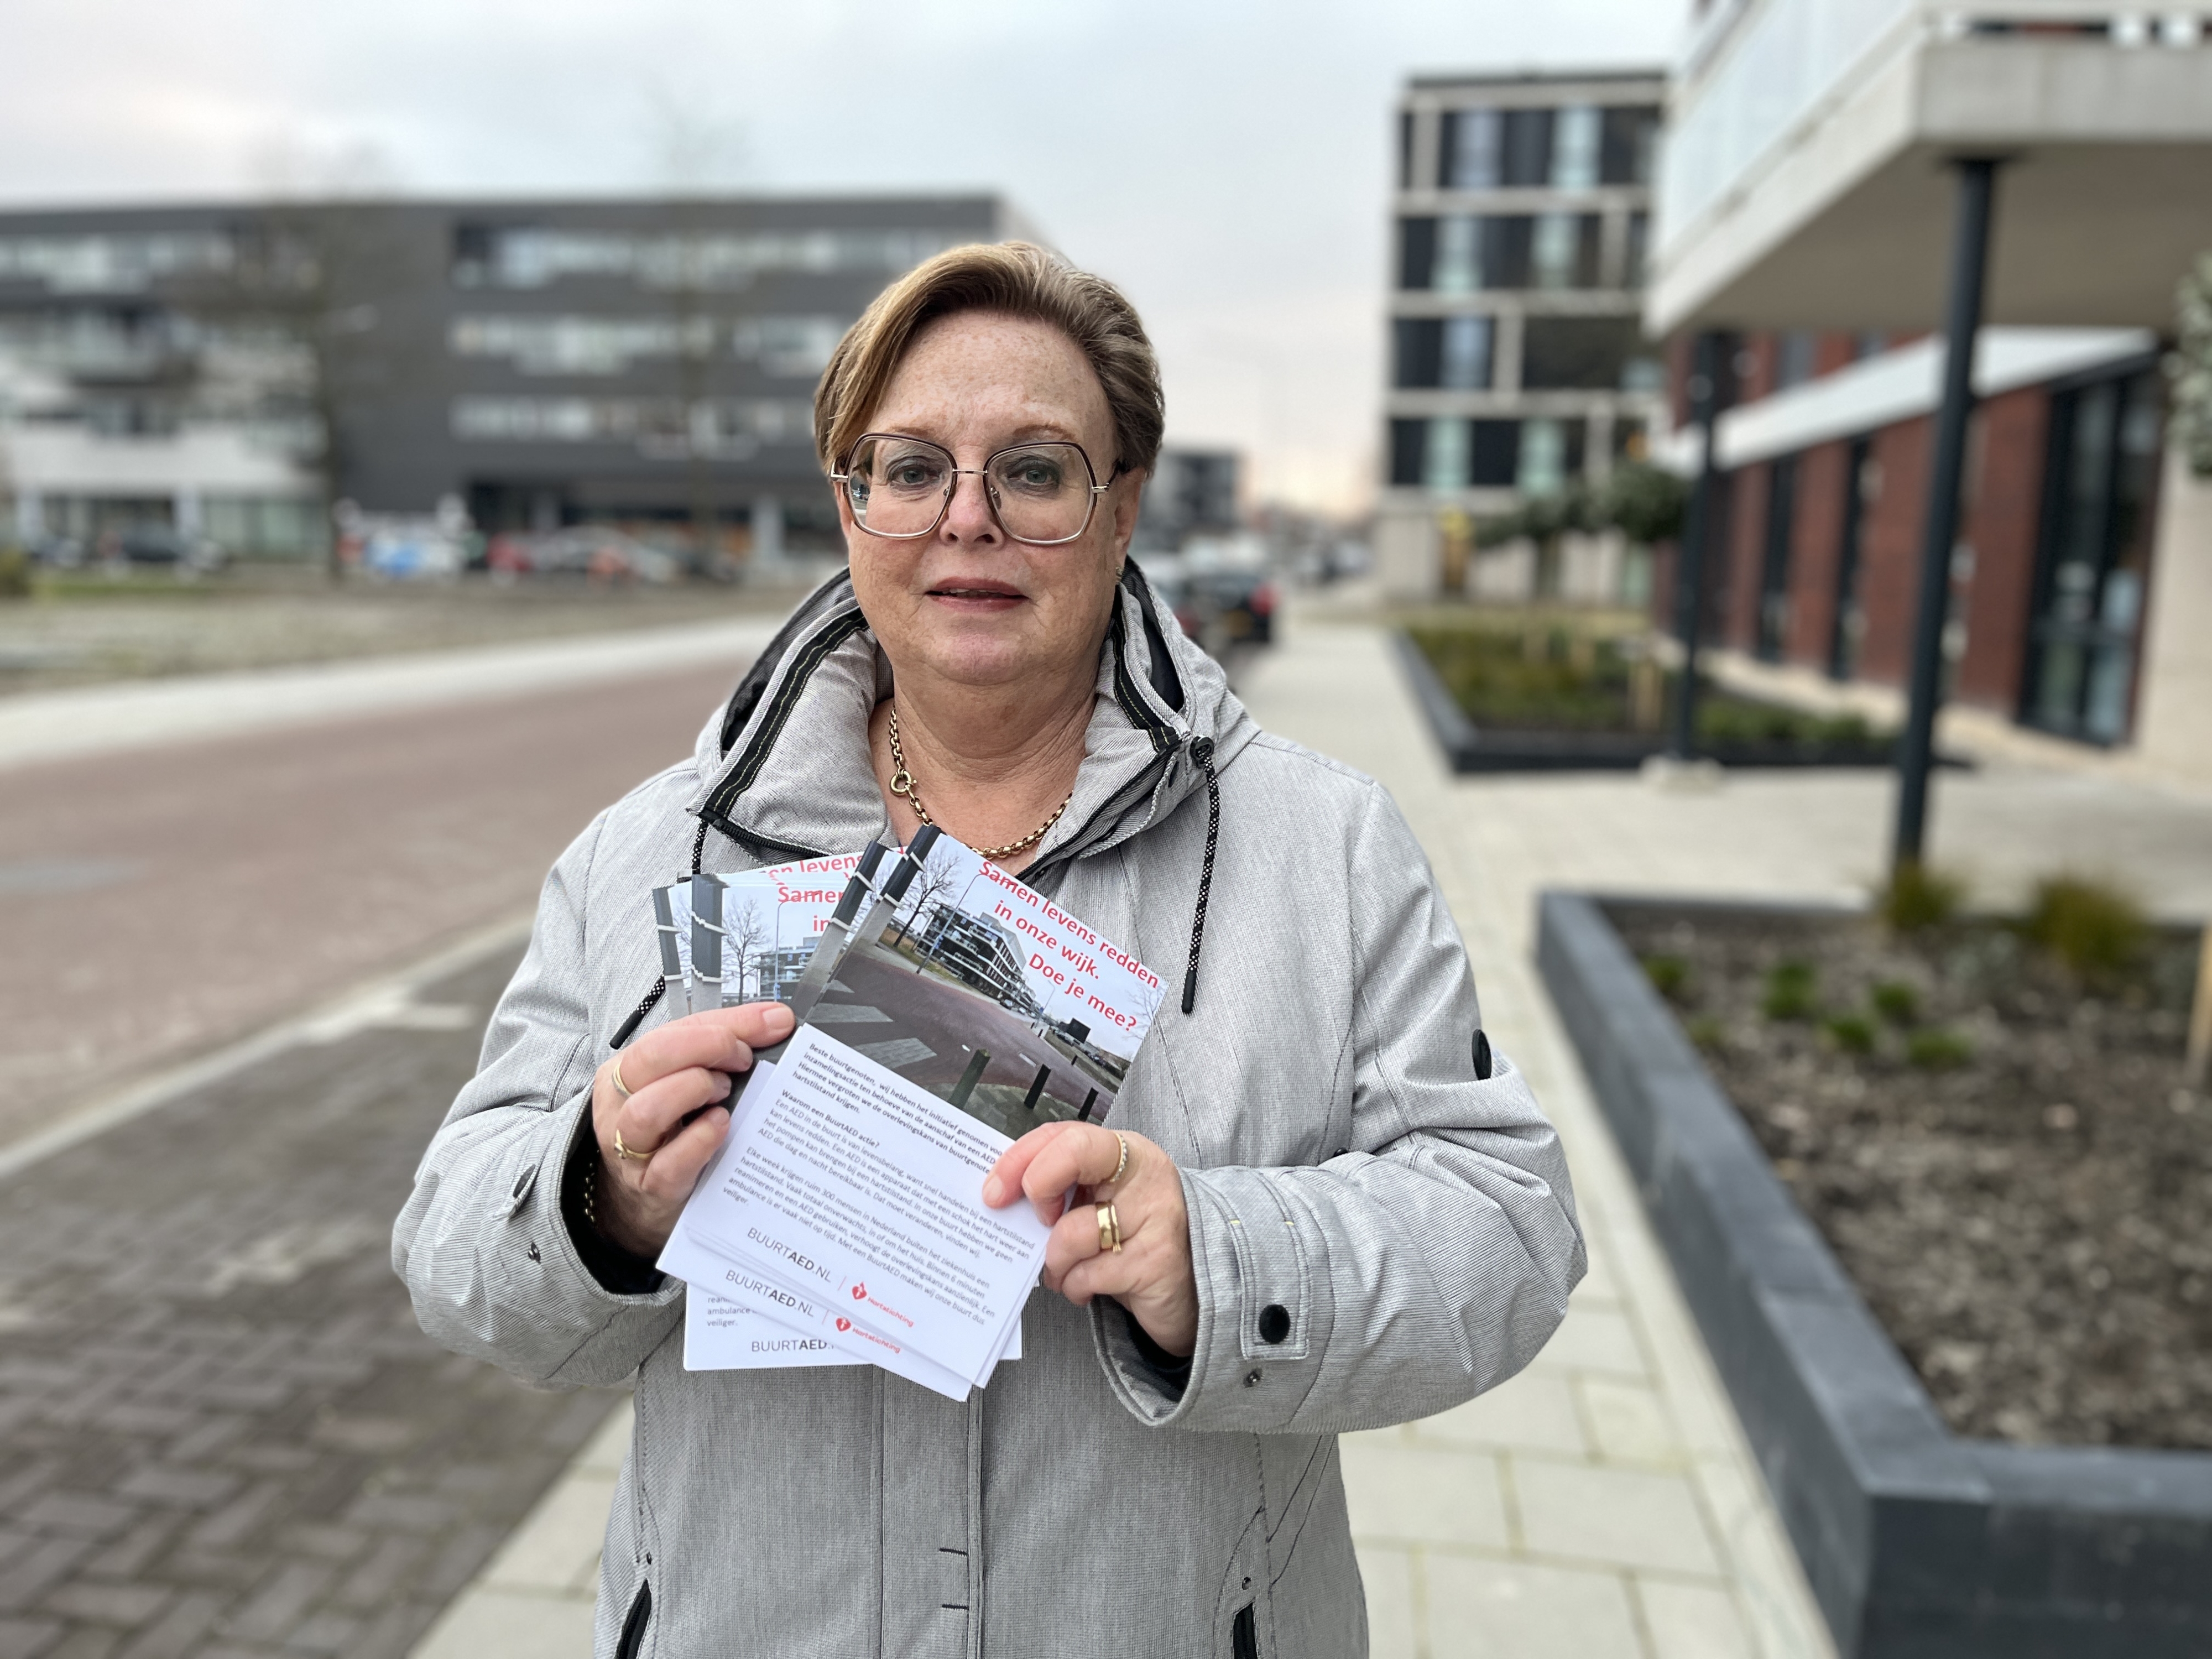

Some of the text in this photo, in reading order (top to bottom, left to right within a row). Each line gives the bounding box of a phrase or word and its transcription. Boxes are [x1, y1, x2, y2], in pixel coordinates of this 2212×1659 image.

[979, 859, 1158, 988] Samen levens redden
[995, 901, 1098, 978] in onze wijk.
[1029, 954, 1136, 1031] Doe je mee?
[781, 1089, 880, 1149] Waarom een BuurtAED actie?
[792, 1070, 860, 1114] hartstilstand krijgen.
[797, 1061, 990, 1173] Hiermee vergroten we de overlevingskans van buurtgenote
[803, 1051, 995, 1164] inzamelingsactie ten behoeve van de aanschaf van een AED
[808, 1042, 1001, 1155] Beste buurtgenoten, wij hebben het initiatief genomen voo
[746, 1146, 989, 1288] Elke week krijgen ruim 300 mensen in Nederland buiten het ziekenhuis een
[757, 1128, 773, 1139] AED
[773, 1136, 784, 1146] die
[785, 1143, 798, 1155] dag
[798, 1151, 807, 1160] en
[808, 1156, 828, 1171] nacht
[828, 1166, 864, 1191] bereikbaar
[873, 1192, 886, 1204] Dat
[885, 1201, 904, 1214] moet
[946, 1234, 968, 1250] vinden
[763, 1117, 776, 1129] het
[775, 1126, 805, 1145] pompen
[805, 1140, 817, 1152] kan
[818, 1148, 846, 1168] brengen
[847, 1164, 857, 1175] bij
[856, 1171, 869, 1182] een
[914, 1202, 921, 1211] In
[921, 1208, 938, 1220] onze
[938, 1216, 958, 1232] buurt
[958, 1227, 984, 1246] hebben
[984, 1243, 995, 1253] we
[994, 1250, 1013, 1263] geen
[769, 1108, 782, 1119] kan
[782, 1115, 805, 1132] levens
[832, 1142, 845, 1155] Een
[845, 1151, 860, 1163] AED
[860, 1159, 867, 1167] is
[867, 1165, 880, 1175] een
[880, 1172, 911, 1192] apparaat
[911, 1189, 923, 1199] dat
[922, 1196, 937, 1207] met
[937, 1204, 951, 1215] een
[951, 1212, 970, 1227] schok
[971, 1222, 983, 1233] het
[983, 1229, 998, 1242] hart
[999, 1239, 1016, 1251] weer
[1016, 1249, 1029, 1259] aan
[775, 1098, 789, 1110] Een
[788, 1107, 804, 1118] AED
[804, 1114, 811, 1123] in
[811, 1120, 821, 1129] de
[821, 1124, 841, 1140] buurt
[841, 1135, 847, 1144] is
[848, 1140, 860, 1151] van
[906, 1173, 924, 1187] want
[923, 1183, 938, 1195] snel
[938, 1190, 969, 1213] handelen
[969, 1208, 978, 1219] bij
[979, 1215, 992, 1225] een
[993, 1222, 1035, 1249] hartstilstand
[726, 1270, 813, 1317] BUURTAED.NL
[728, 1177, 766, 1201] ambulance
[766, 1197, 773, 1205] is
[782, 1207, 798, 1219] vaak
[798, 1216, 813, 1228] niet
[812, 1224, 822, 1233] op
[837, 1237, 853, 1250] Met
[852, 1247, 866, 1258] een
[866, 1253, 900, 1276] BuurtAED
[899, 1274, 923, 1290] maken
[924, 1287, 935, 1297] wij
[935, 1293, 951, 1306] onze
[952, 1301, 972, 1317] buurt
[972, 1314, 984, 1325] dus
[734, 1167, 774, 1192] reanimeren
[774, 1190, 784, 1198] en
[784, 1196, 798, 1206] een
[797, 1202, 813, 1214] AED
[850, 1232, 880, 1253] verhoogt
[881, 1250, 890, 1258] de
[891, 1255, 943, 1288] overlevingskans
[981, 1305, 995, 1317] Een
[748, 1228, 831, 1282] BUURTAED.NL
[786, 1181, 802, 1195] Vaak
[802, 1191, 824, 1207] totaal
[868, 1228, 875, 1237] in
[884, 1239, 896, 1249] om
[896, 1244, 909, 1256] het
[926, 1260, 950, 1279] Binnen
[956, 1279, 985, 1298] minuten
